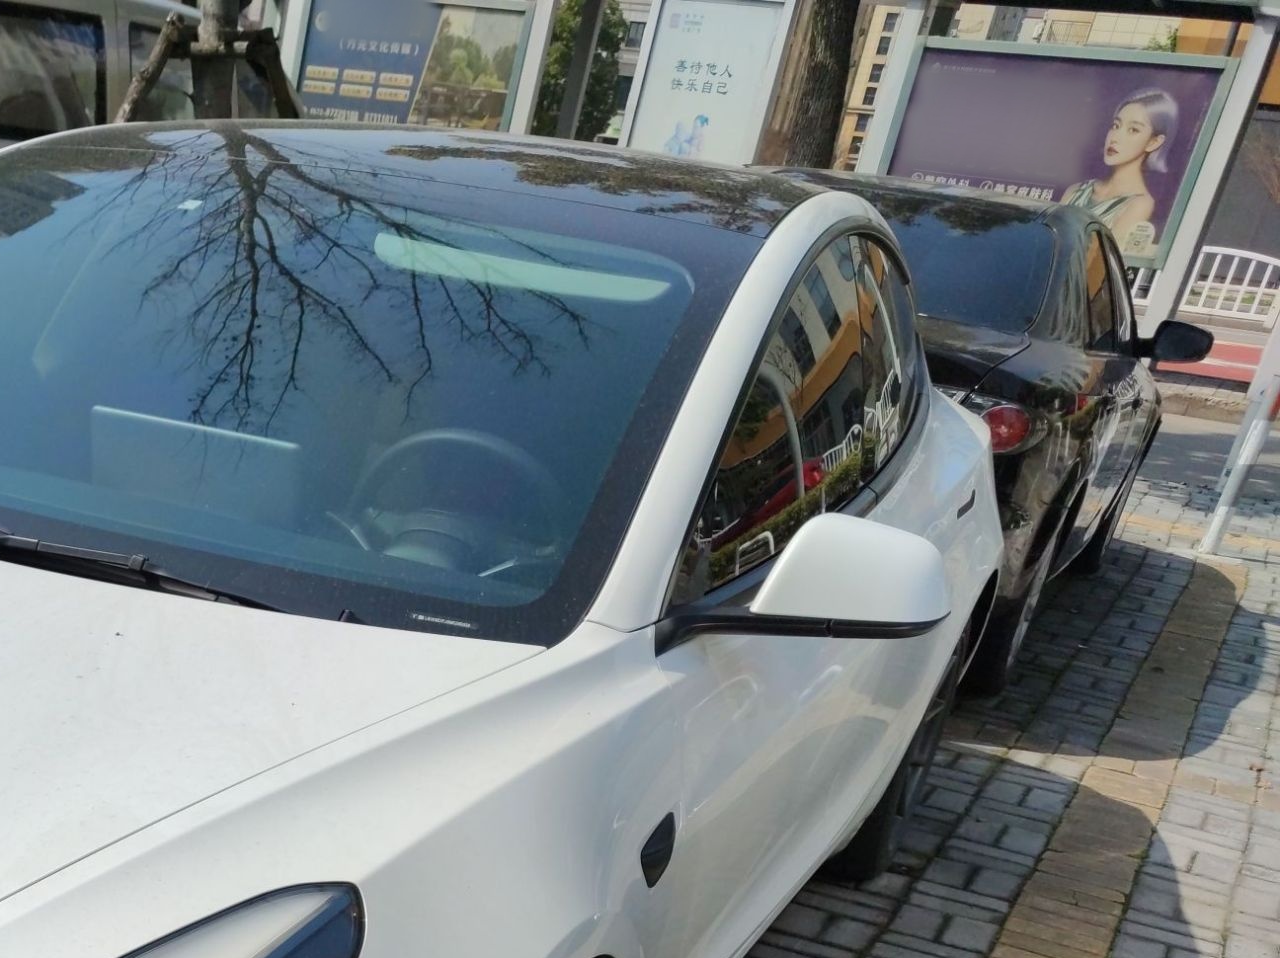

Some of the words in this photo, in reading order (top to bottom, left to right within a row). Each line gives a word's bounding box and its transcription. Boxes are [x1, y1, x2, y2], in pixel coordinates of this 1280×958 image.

[674, 59, 733, 79] 善待他人
[671, 78, 729, 96] 快乐自己
